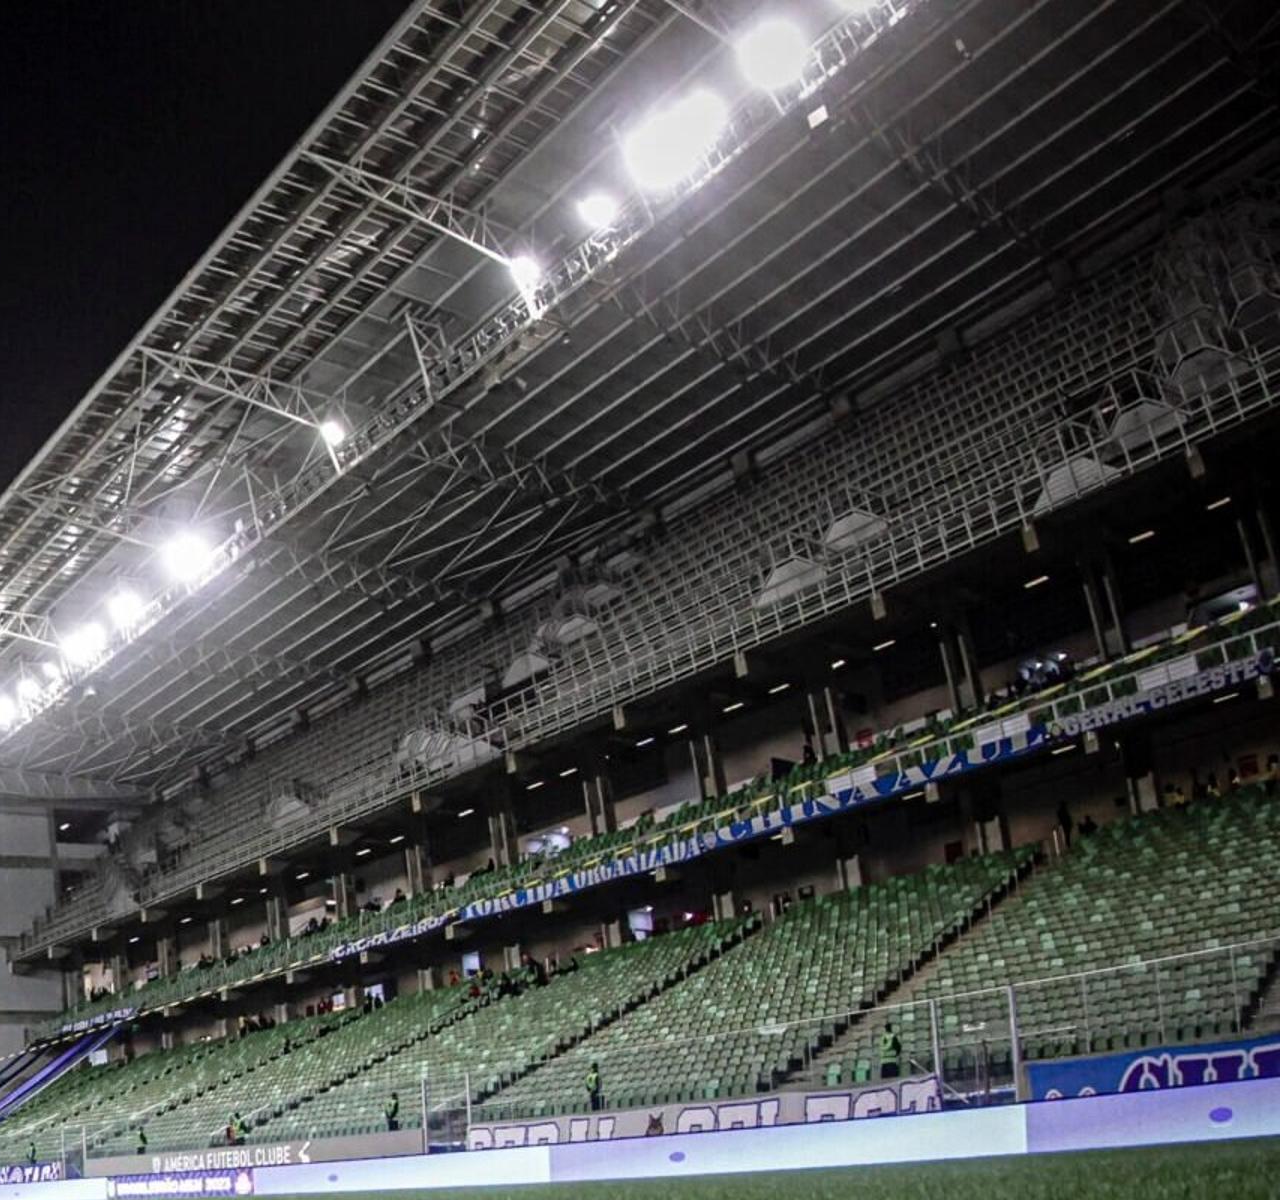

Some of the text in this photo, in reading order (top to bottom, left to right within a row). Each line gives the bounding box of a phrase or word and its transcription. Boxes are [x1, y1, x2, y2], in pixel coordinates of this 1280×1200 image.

[1064, 658, 1259, 736] GERAL CELESTE
[462, 833, 702, 919] TORCIDA ORGANIZADA
[164, 1145, 291, 1172] AMÉRICA FUTEBOL CLUBE
